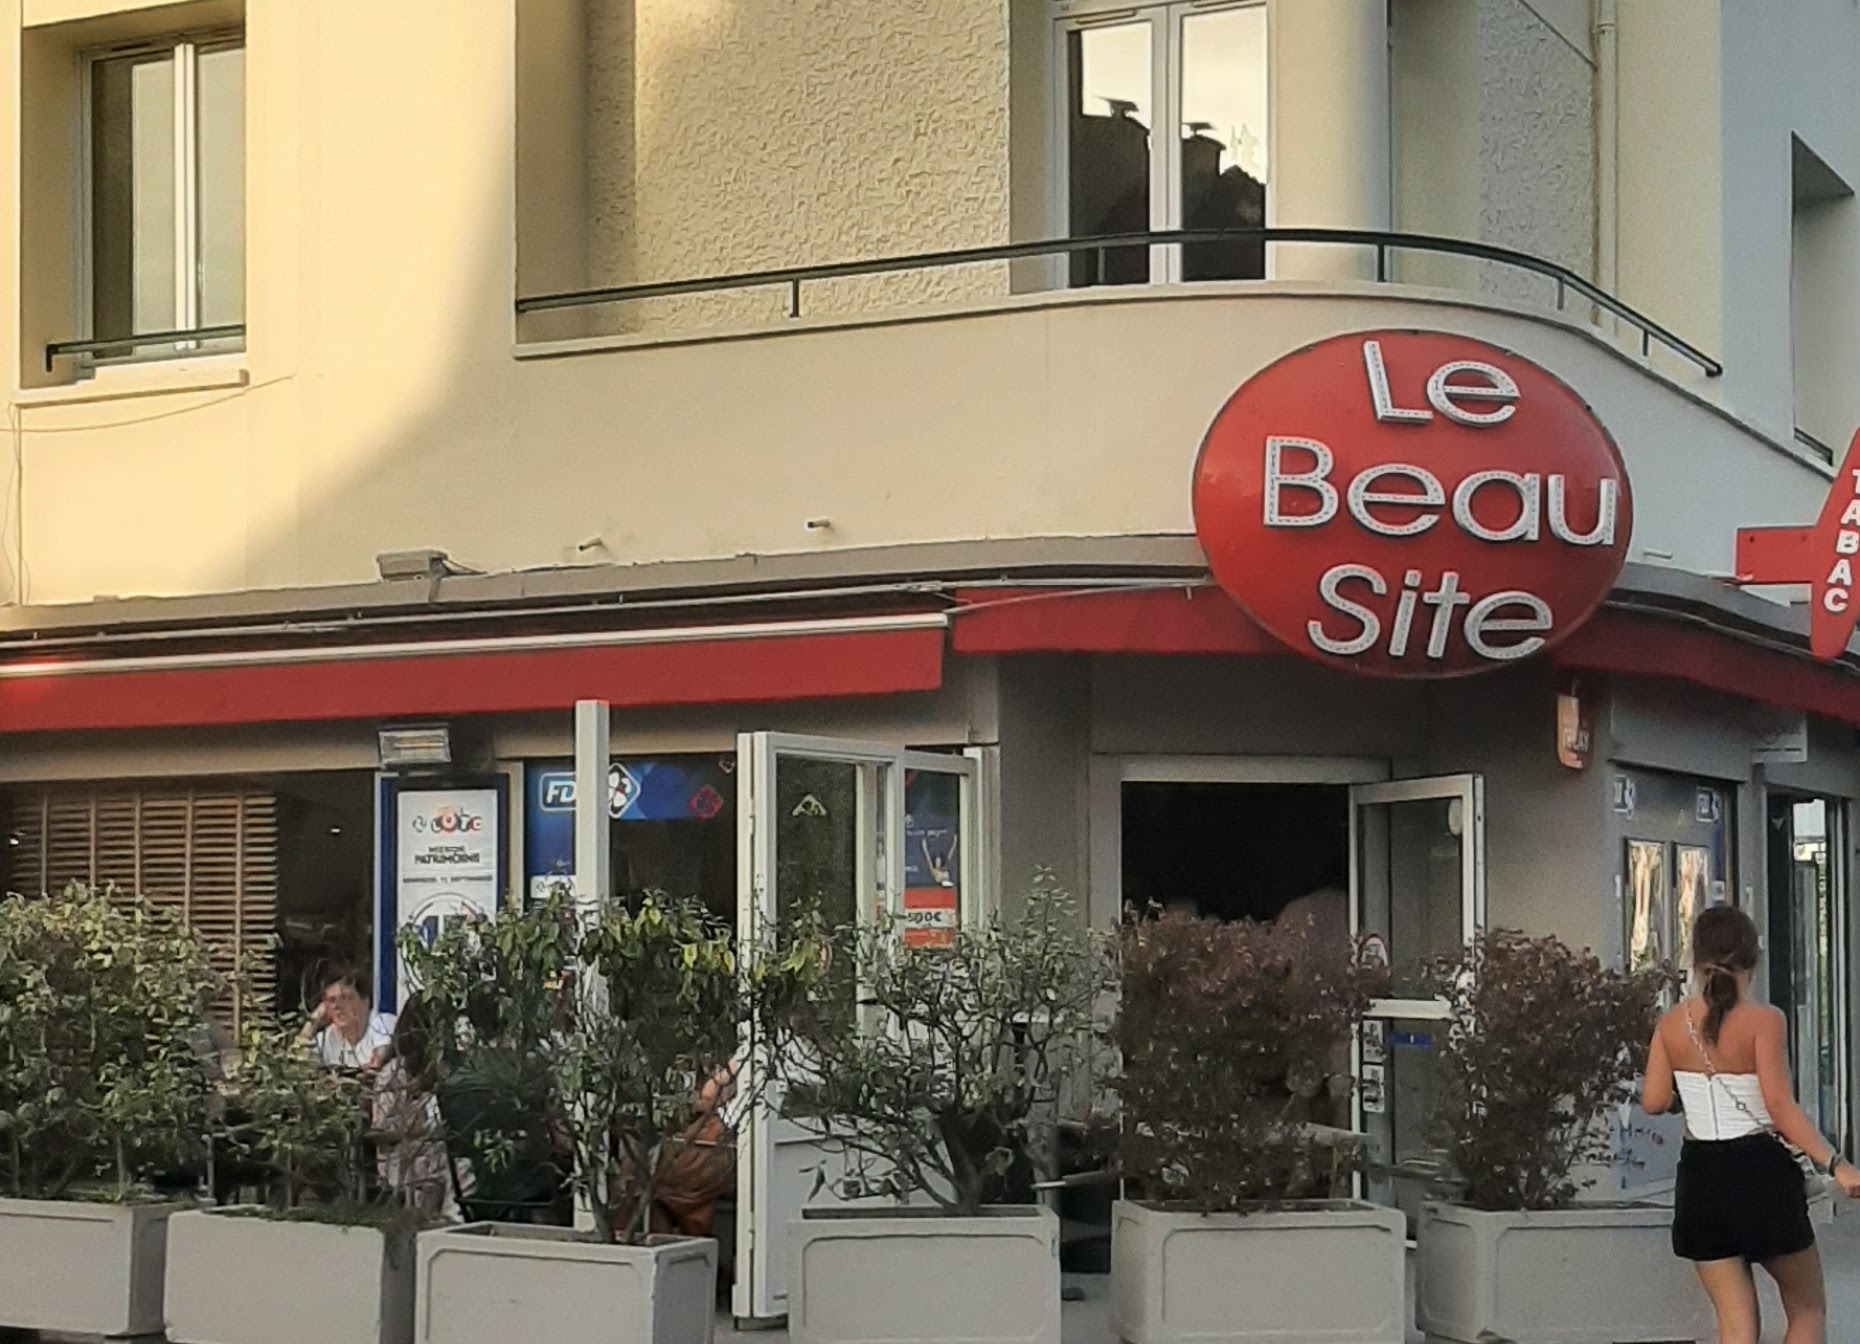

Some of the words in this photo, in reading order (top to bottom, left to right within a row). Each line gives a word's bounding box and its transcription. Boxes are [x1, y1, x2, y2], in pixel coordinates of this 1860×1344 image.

[1363, 340, 1521, 428] Le
[1262, 435, 1617, 547] Beau
[1823, 468, 1860, 612] TABAC
[1307, 563, 1554, 660] Site
